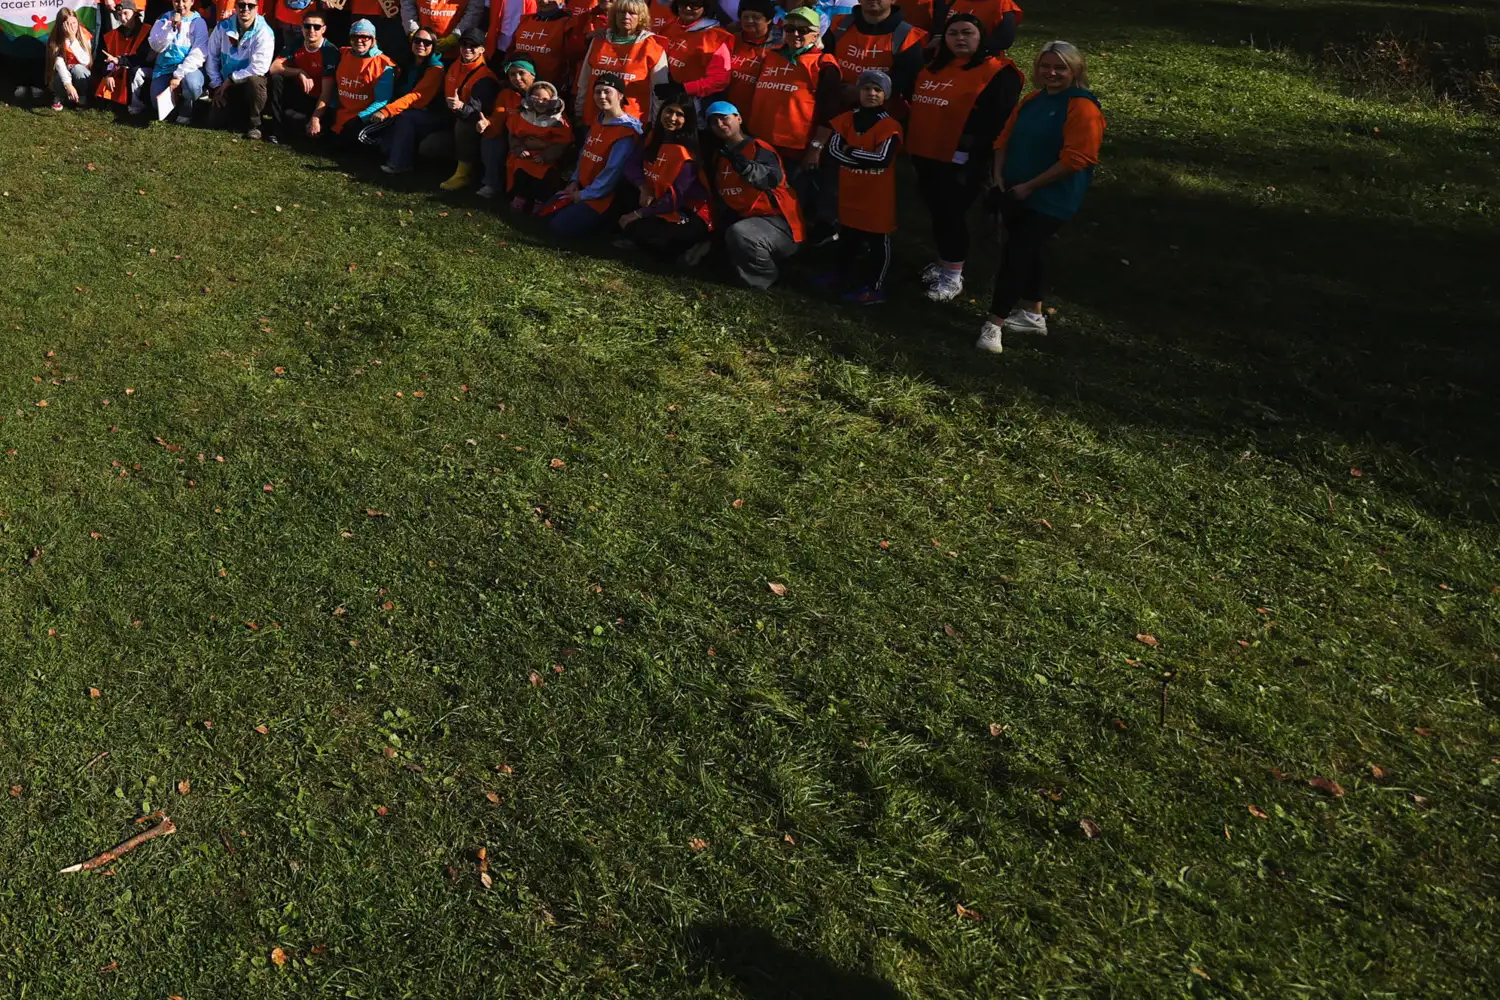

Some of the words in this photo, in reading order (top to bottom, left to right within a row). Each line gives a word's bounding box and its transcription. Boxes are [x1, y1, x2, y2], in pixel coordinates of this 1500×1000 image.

[520, 29, 548, 40] ЭН+
[847, 43, 883, 60] ЭН+
[598, 53, 632, 66] ЭН+
[763, 63, 793, 77] ЭН+
[341, 75, 362, 88] ЭН+
[920, 80, 953, 91] ЭН+
[338, 89, 369, 101] ОЛОНТЕР
